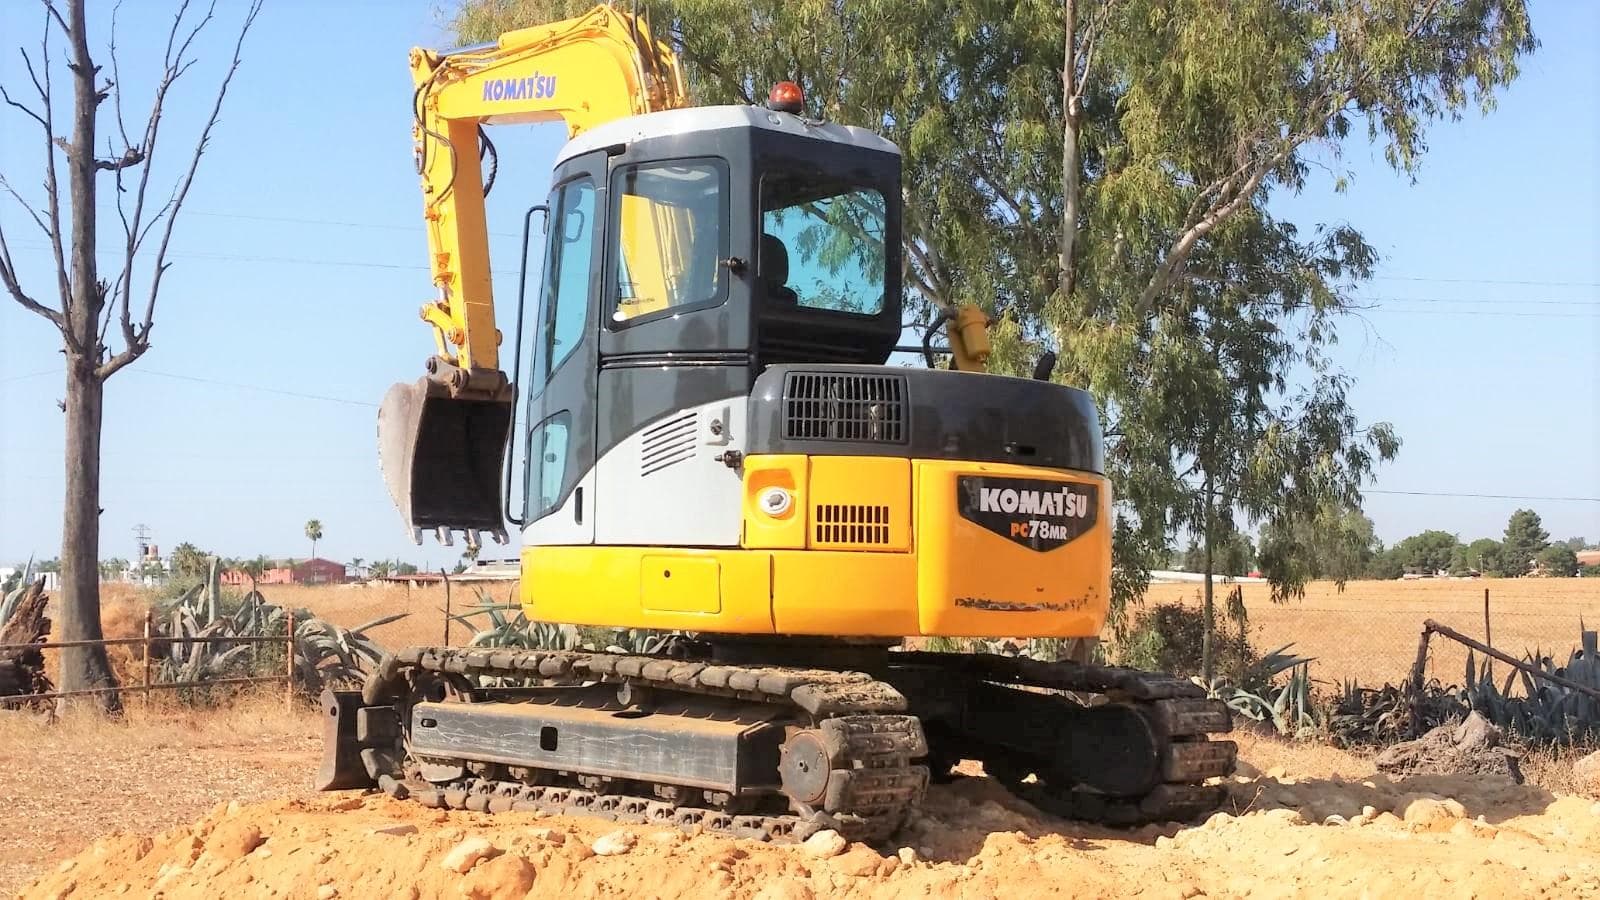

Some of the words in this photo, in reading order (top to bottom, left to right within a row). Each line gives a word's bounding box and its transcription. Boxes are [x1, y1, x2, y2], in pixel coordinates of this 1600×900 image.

[483, 70, 556, 101] KOMATSU
[979, 486, 1087, 518] KOMATSU
[1010, 521, 1067, 540] PC78MR
